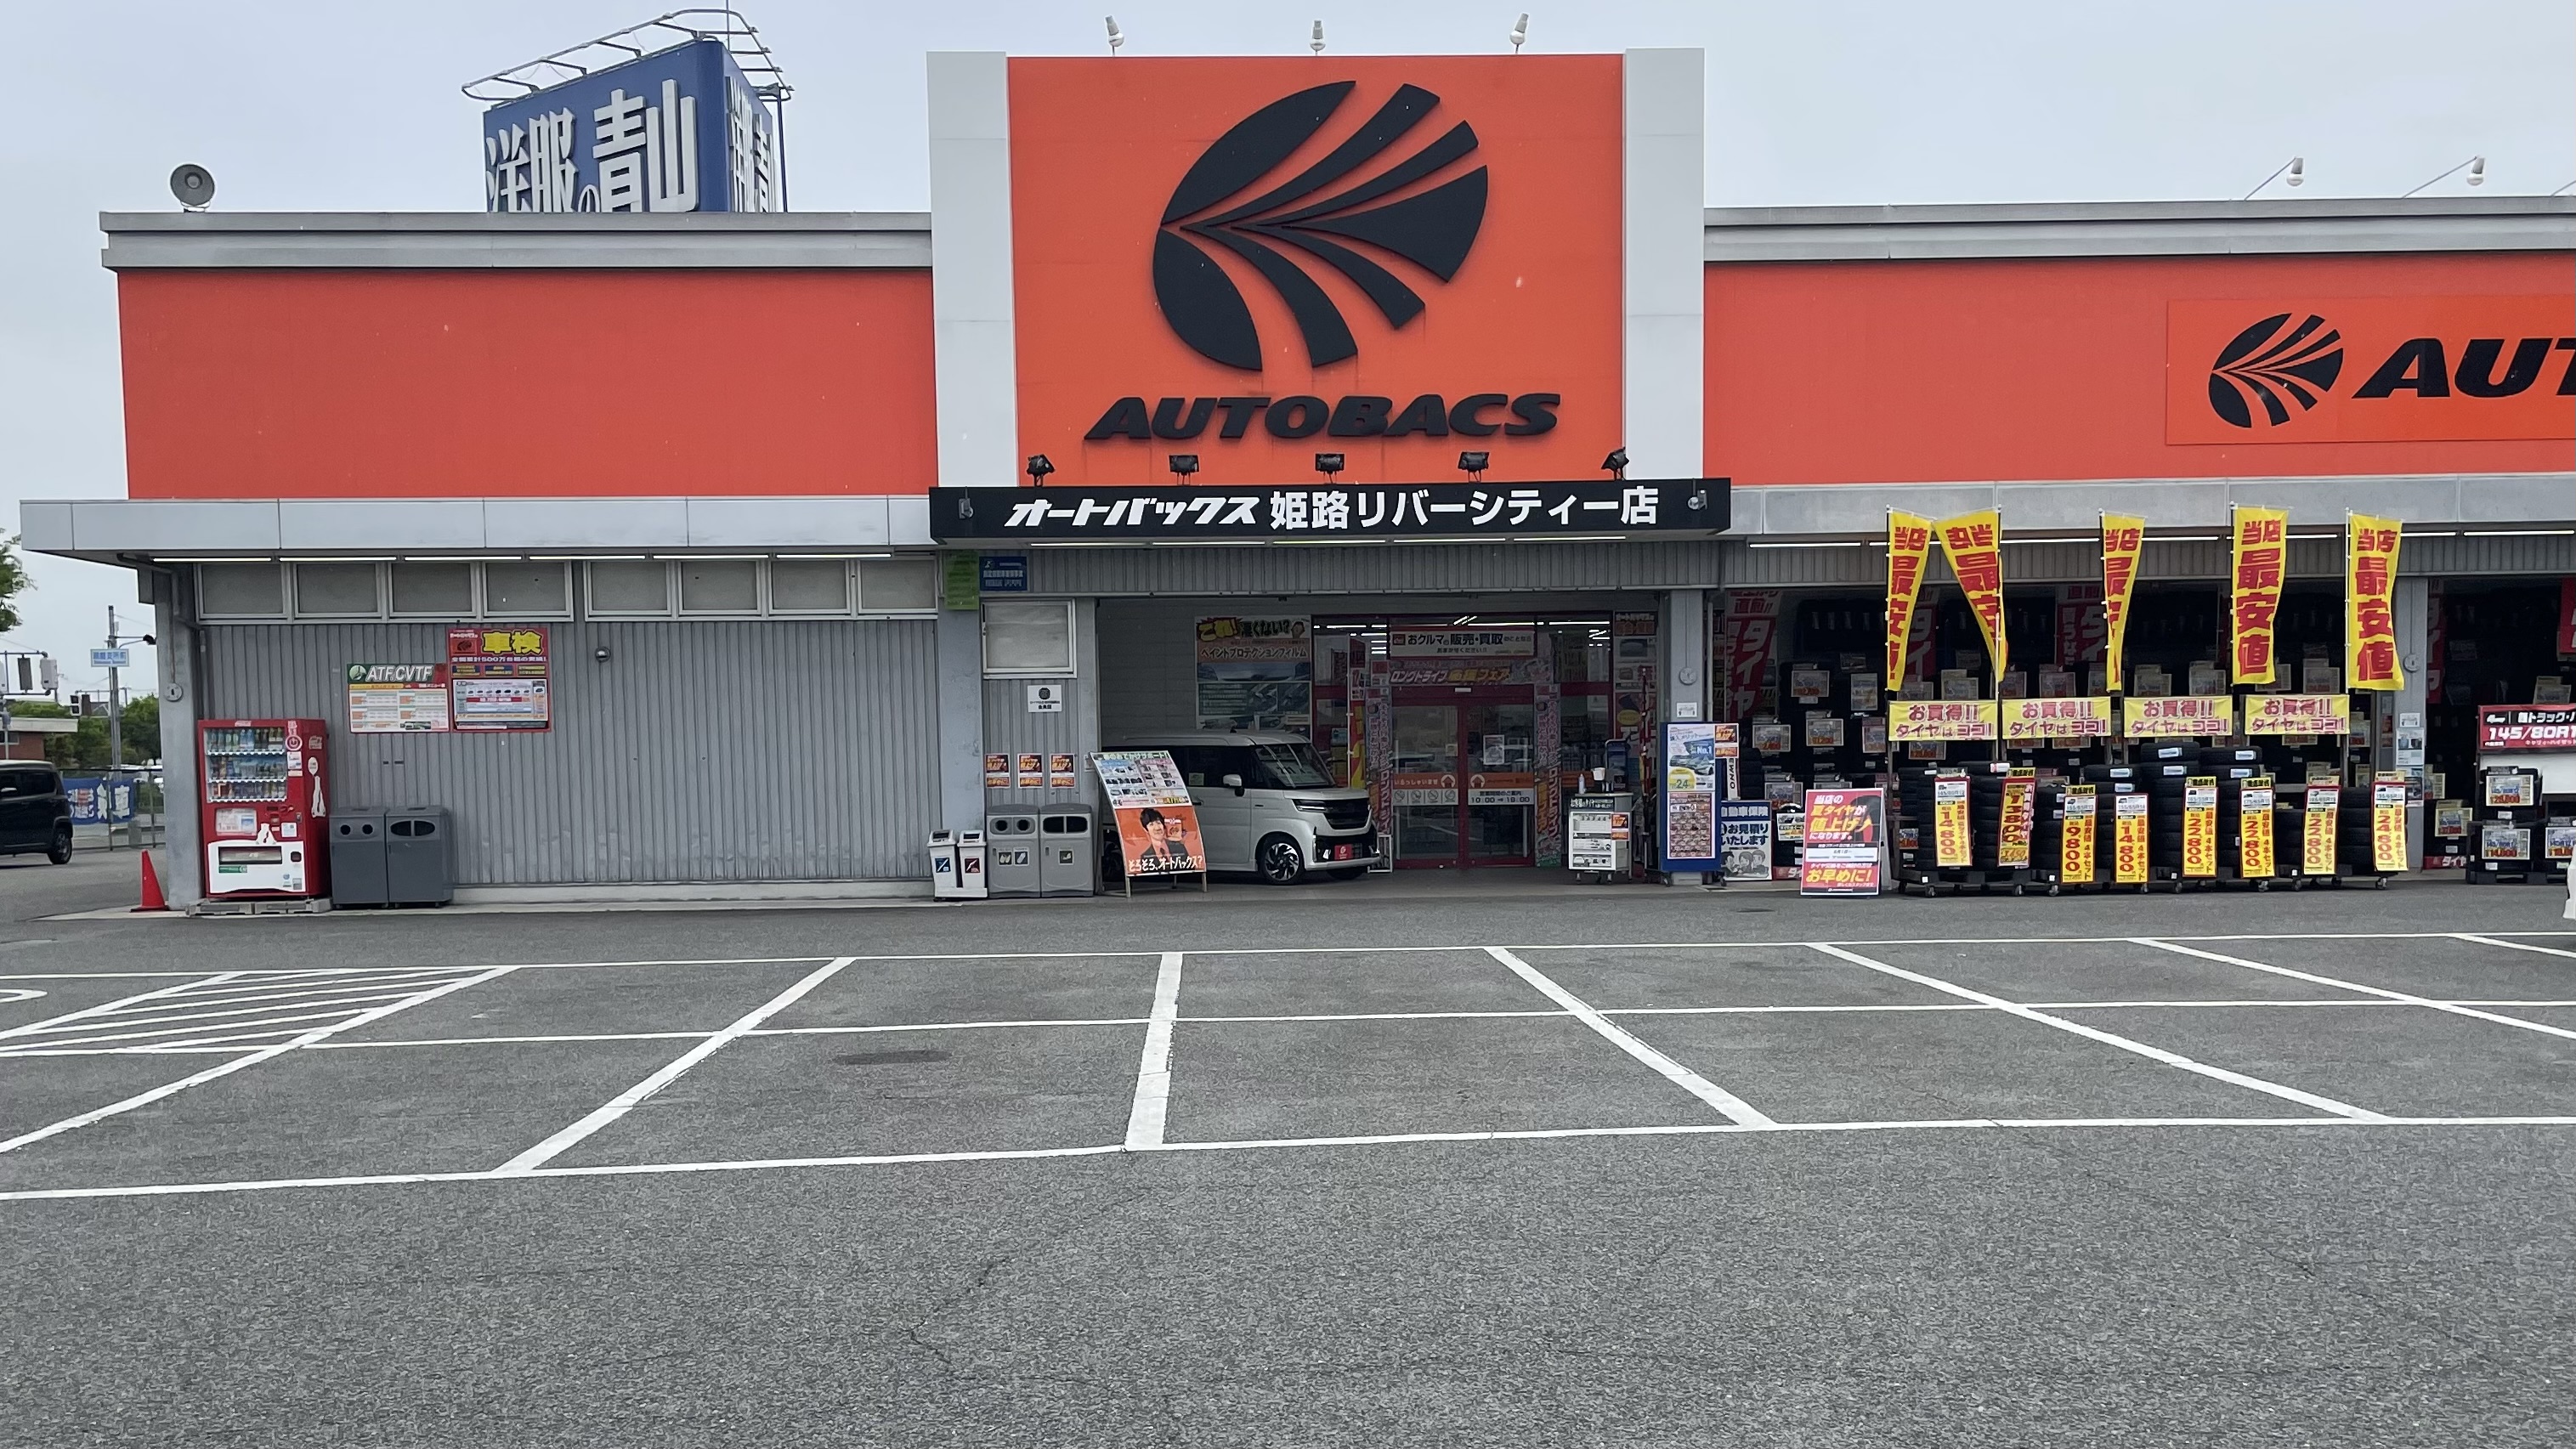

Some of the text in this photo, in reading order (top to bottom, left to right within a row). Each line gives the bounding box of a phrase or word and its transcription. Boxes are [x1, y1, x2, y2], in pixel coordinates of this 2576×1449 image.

[2351, 337, 2576, 399] AU
[1084, 393, 1561, 441] AUTOBACS
[1004, 486, 1660, 530] オートバックス 姫路リバーシティー店
[2240, 519, 2282, 546] 当店
[2357, 529, 2398, 552] 当店
[2236, 547, 2281, 677] 最安値
[2355, 557, 2394, 682] 最安値
[483, 631, 542, 654] 車検
[1810, 805, 1867, 817] 夏タイヤが
[1814, 795, 1844, 805] 当店の
[1809, 817, 1860, 833] 値上げ
[1809, 832, 1853, 841] になります。
[1721, 835, 1769, 846] いたします
[1806, 869, 1872, 884] お早めに!
